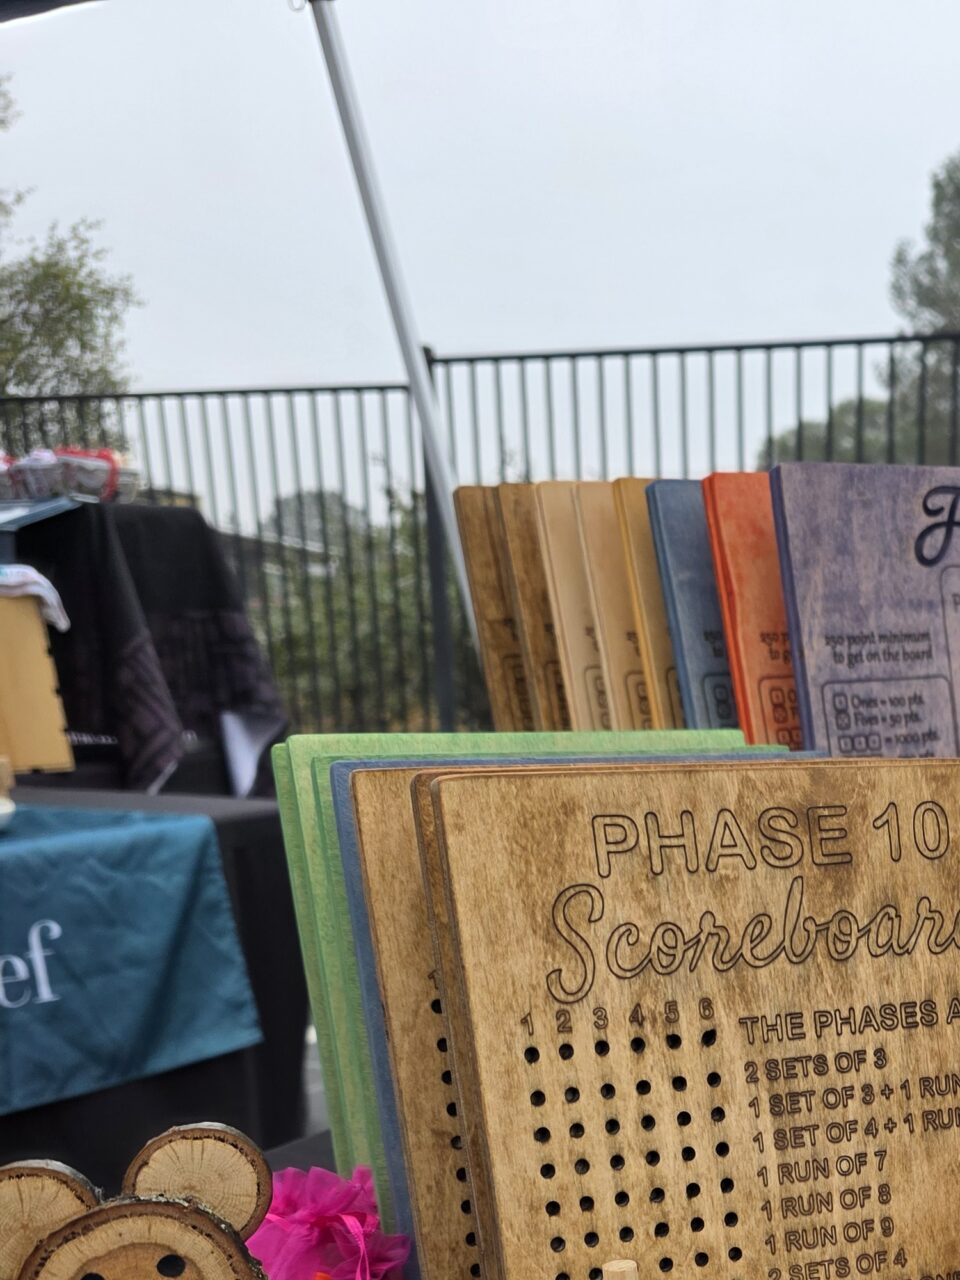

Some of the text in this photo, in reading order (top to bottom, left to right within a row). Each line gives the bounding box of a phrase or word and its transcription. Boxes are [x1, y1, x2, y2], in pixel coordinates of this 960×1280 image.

[833, 645, 933, 668] to get on the board
[846, 632, 876, 647] point
[878, 631, 931, 644] minimum
[591, 801, 950, 878] PHASE 10
[521, 997, 714, 1036] 1 2 3 4 5 6
[739, 1011, 806, 1044] THE
[813, 999, 938, 1037] PHASES
[744, 1048, 887, 1084] 2 SETS OF 3
[749, 1097, 761, 1118] 1
[769, 1090, 816, 1116] SET
[822, 1086, 855, 1109] OF
[861, 1083, 875, 1104] 3
[900, 1079, 911, 1100] 1
